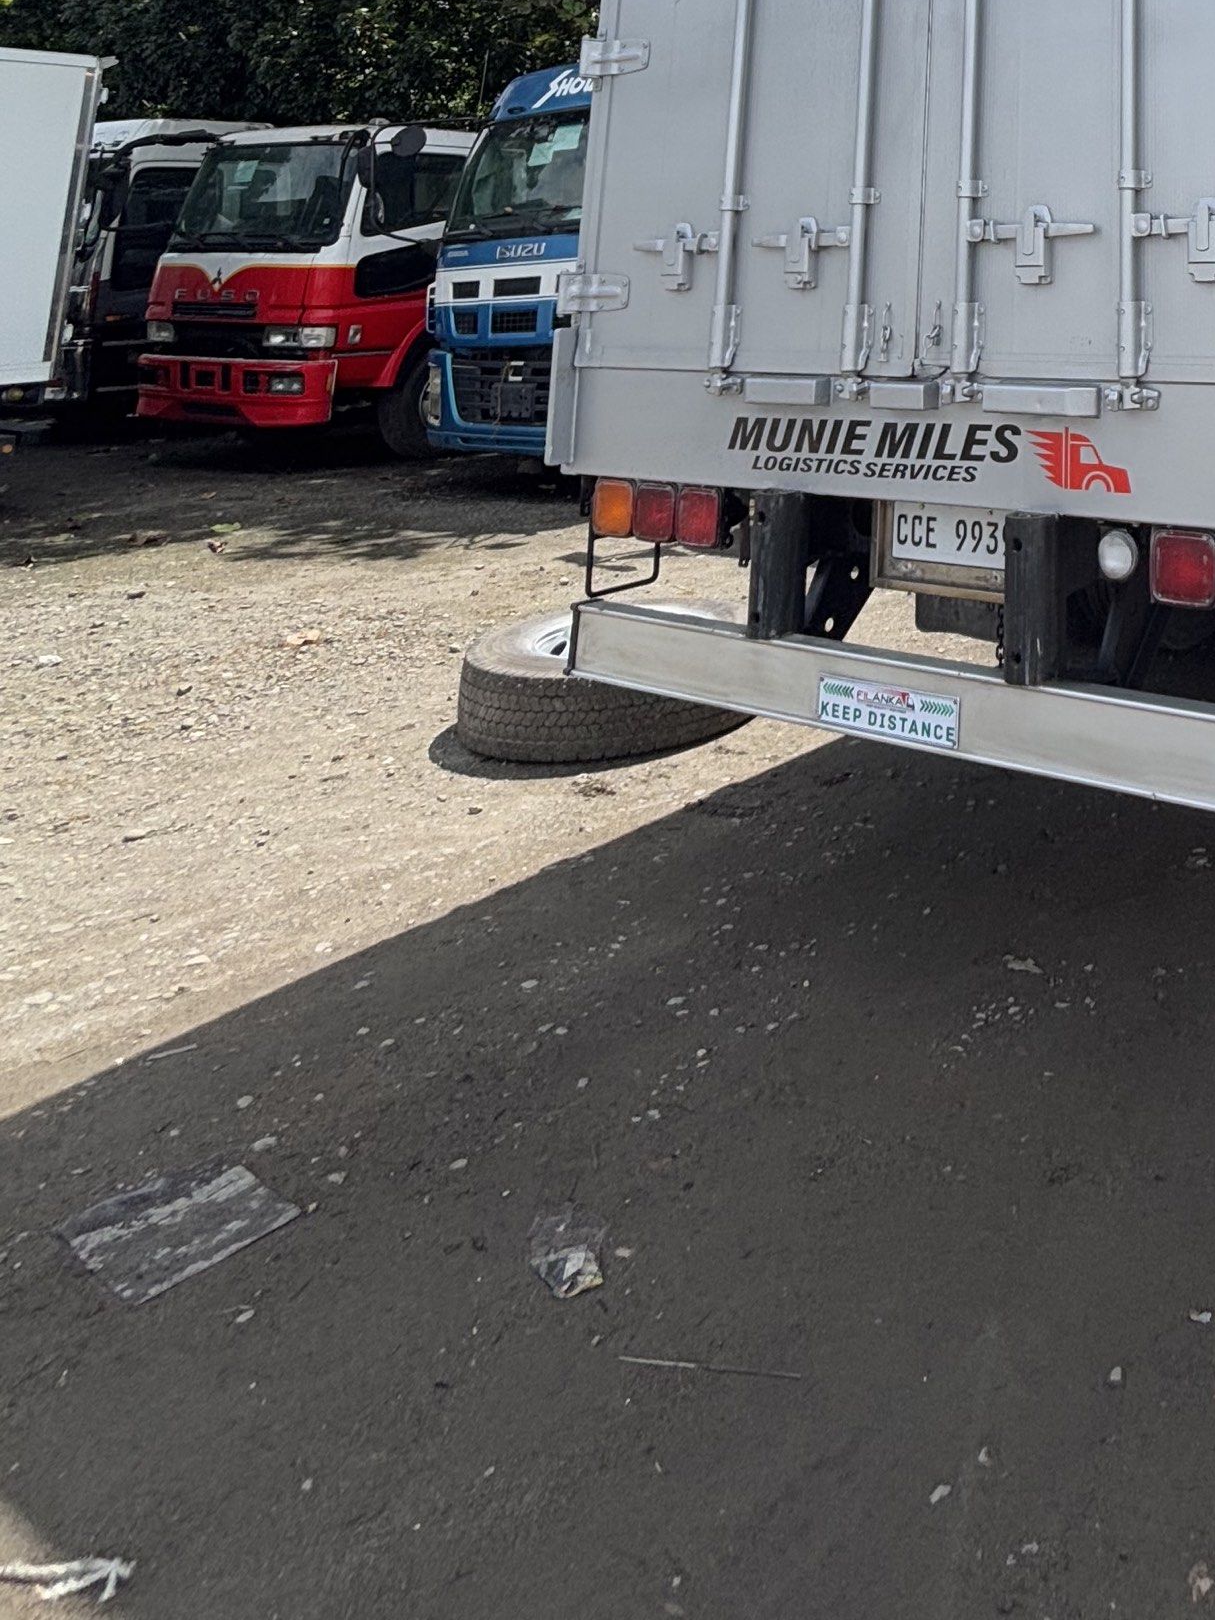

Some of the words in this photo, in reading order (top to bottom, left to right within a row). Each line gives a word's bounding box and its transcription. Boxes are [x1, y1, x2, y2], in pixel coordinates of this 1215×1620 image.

[496, 242, 546, 259] ISUZU
[174, 288, 260, 301] FUSO
[728, 417, 872, 456] MUNIE
[874, 422, 1021, 464] MILES
[751, 455, 860, 476] LOGISTICS
[863, 462, 977, 483] SERVICES
[897, 513, 937, 549] CCE
[955, 519, 1005, 555] 993
[820, 701, 862, 722] KEEP
[868, 711, 956, 743] DISTANCE
